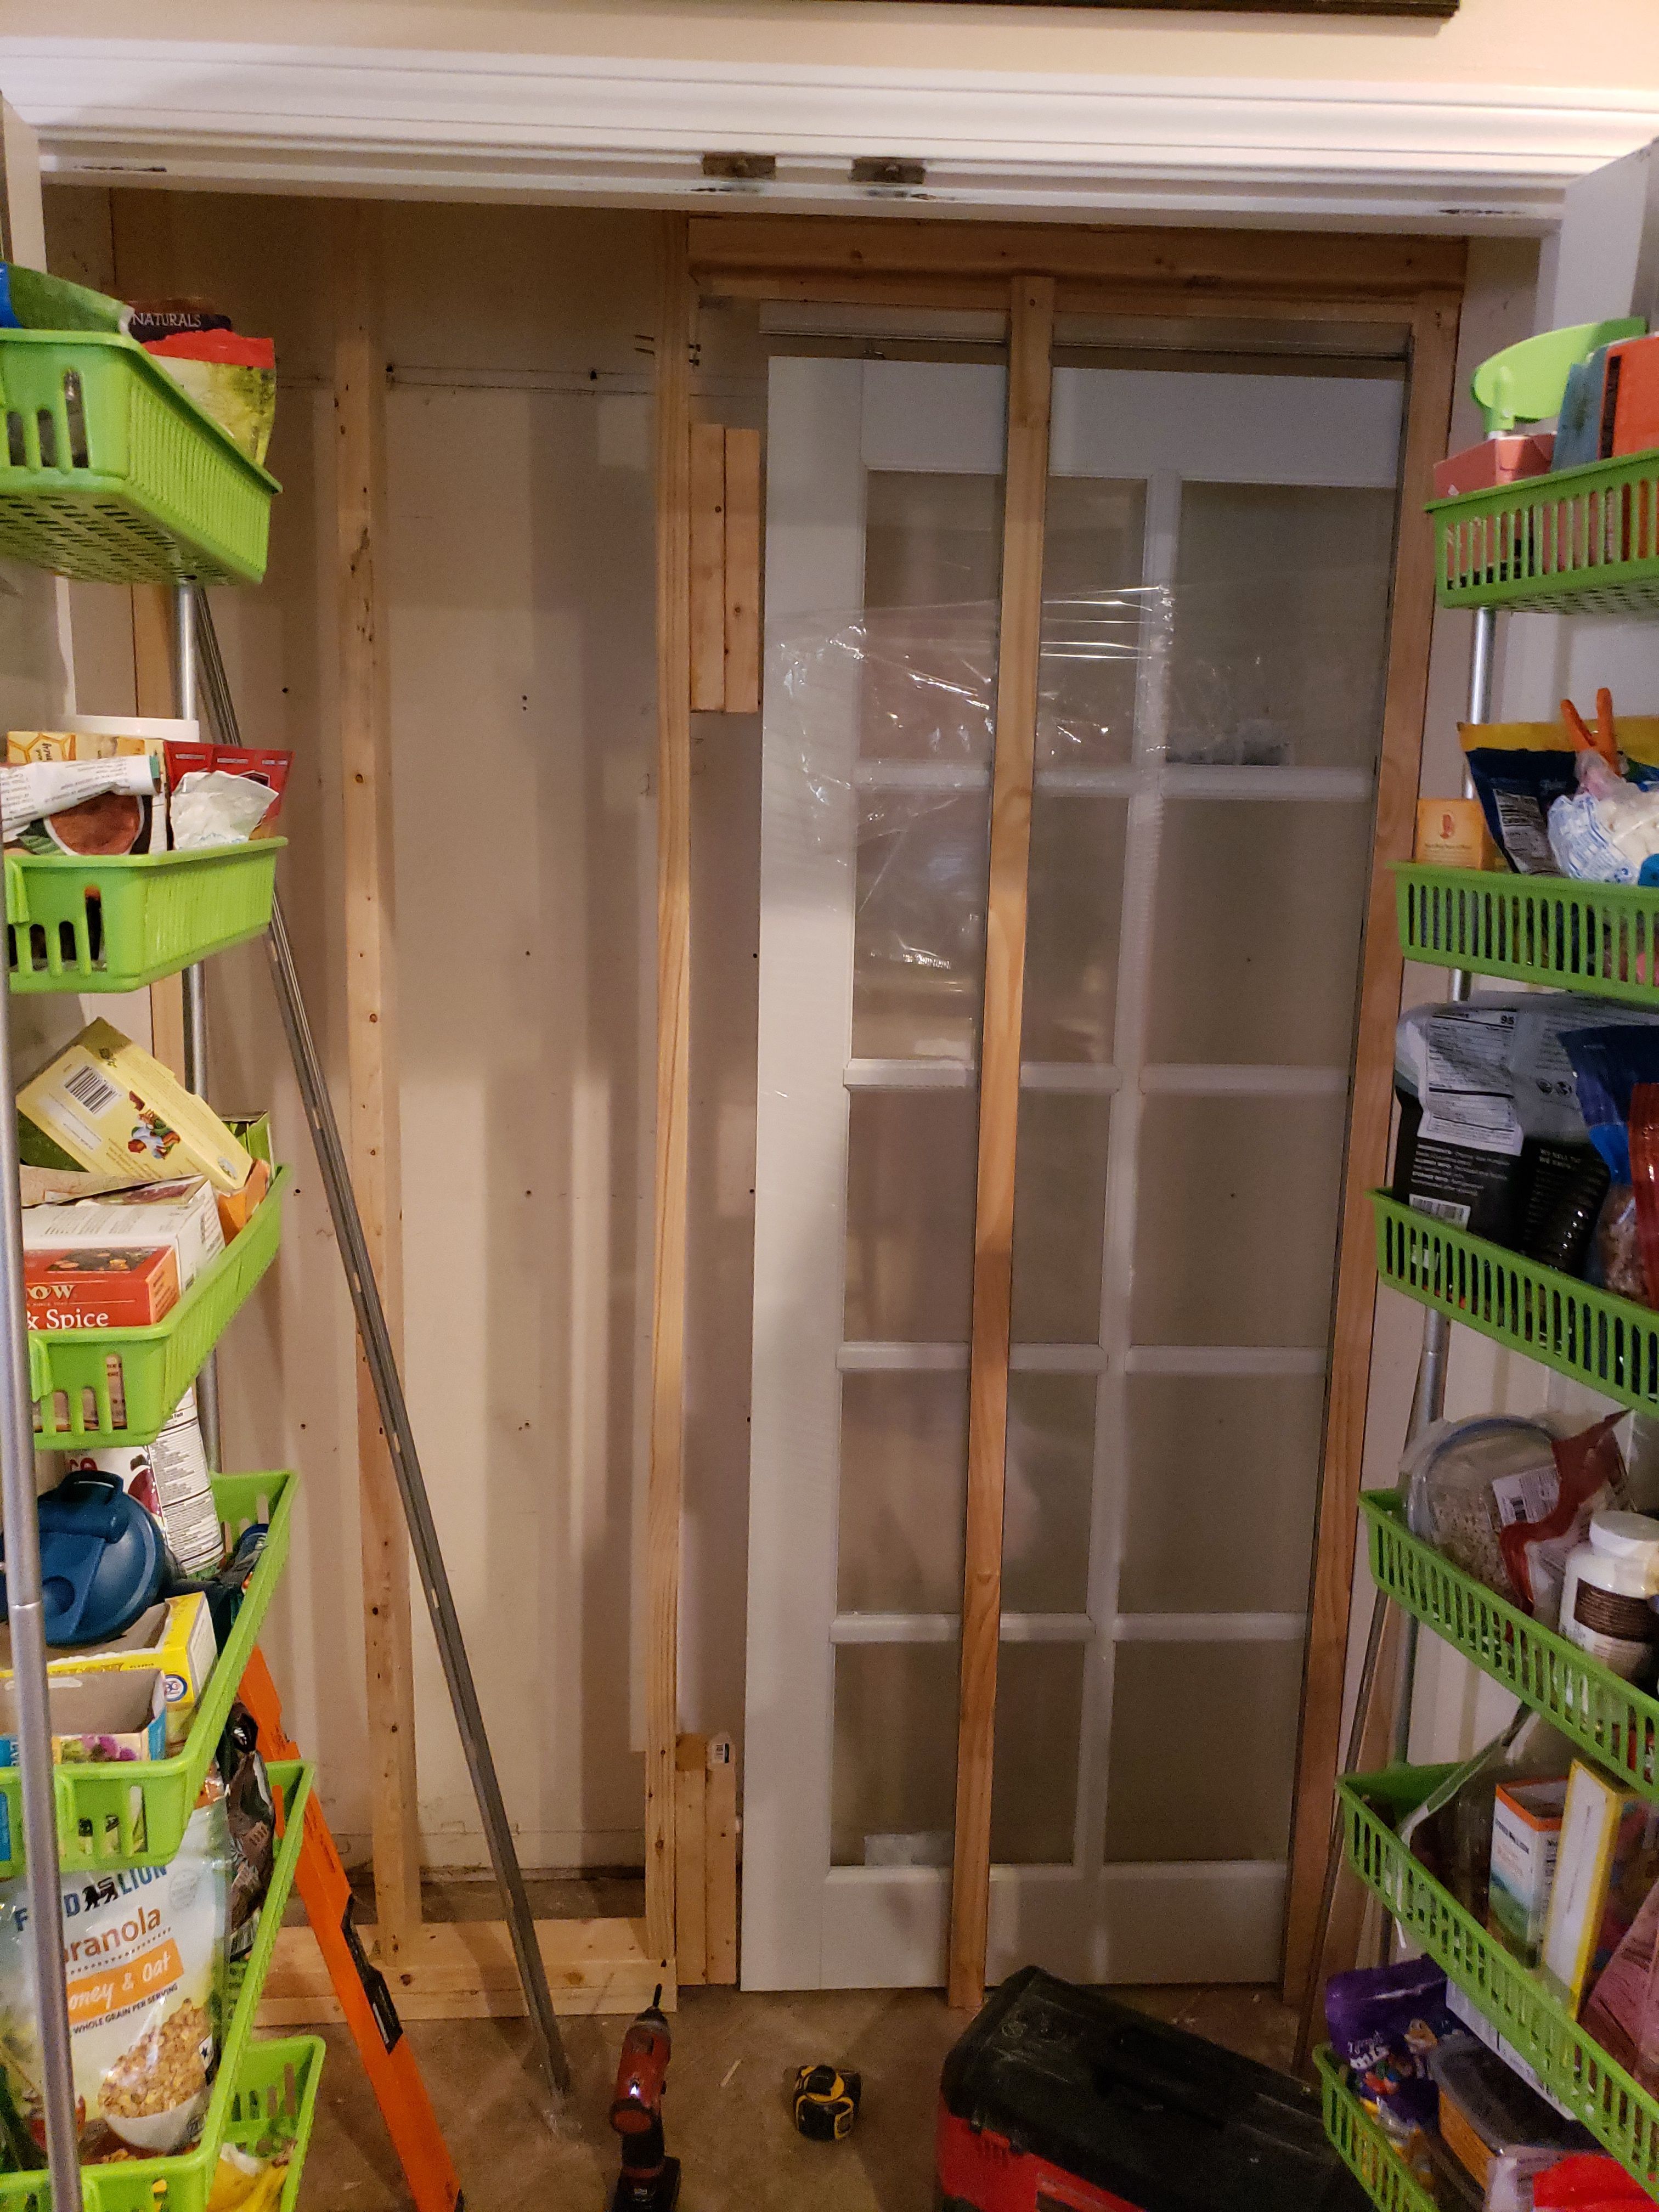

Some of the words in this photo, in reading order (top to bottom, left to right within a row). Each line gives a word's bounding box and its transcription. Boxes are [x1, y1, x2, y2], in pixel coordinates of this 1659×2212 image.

[132, 313, 201, 328] NATURALS
[27, 1284, 76, 1300] OW
[46, 1308, 109, 1329] Spice
[14, 1893, 81, 1932] FD
[64, 1906, 161, 1963] ranola
[69, 1983, 115, 2010] oney
[73, 2017, 104, 2034] WHOLE
[105, 2006, 131, 2023] GRAIN
[132, 2000, 146, 2012] PER
[147, 1982, 178, 2005] SERVING
